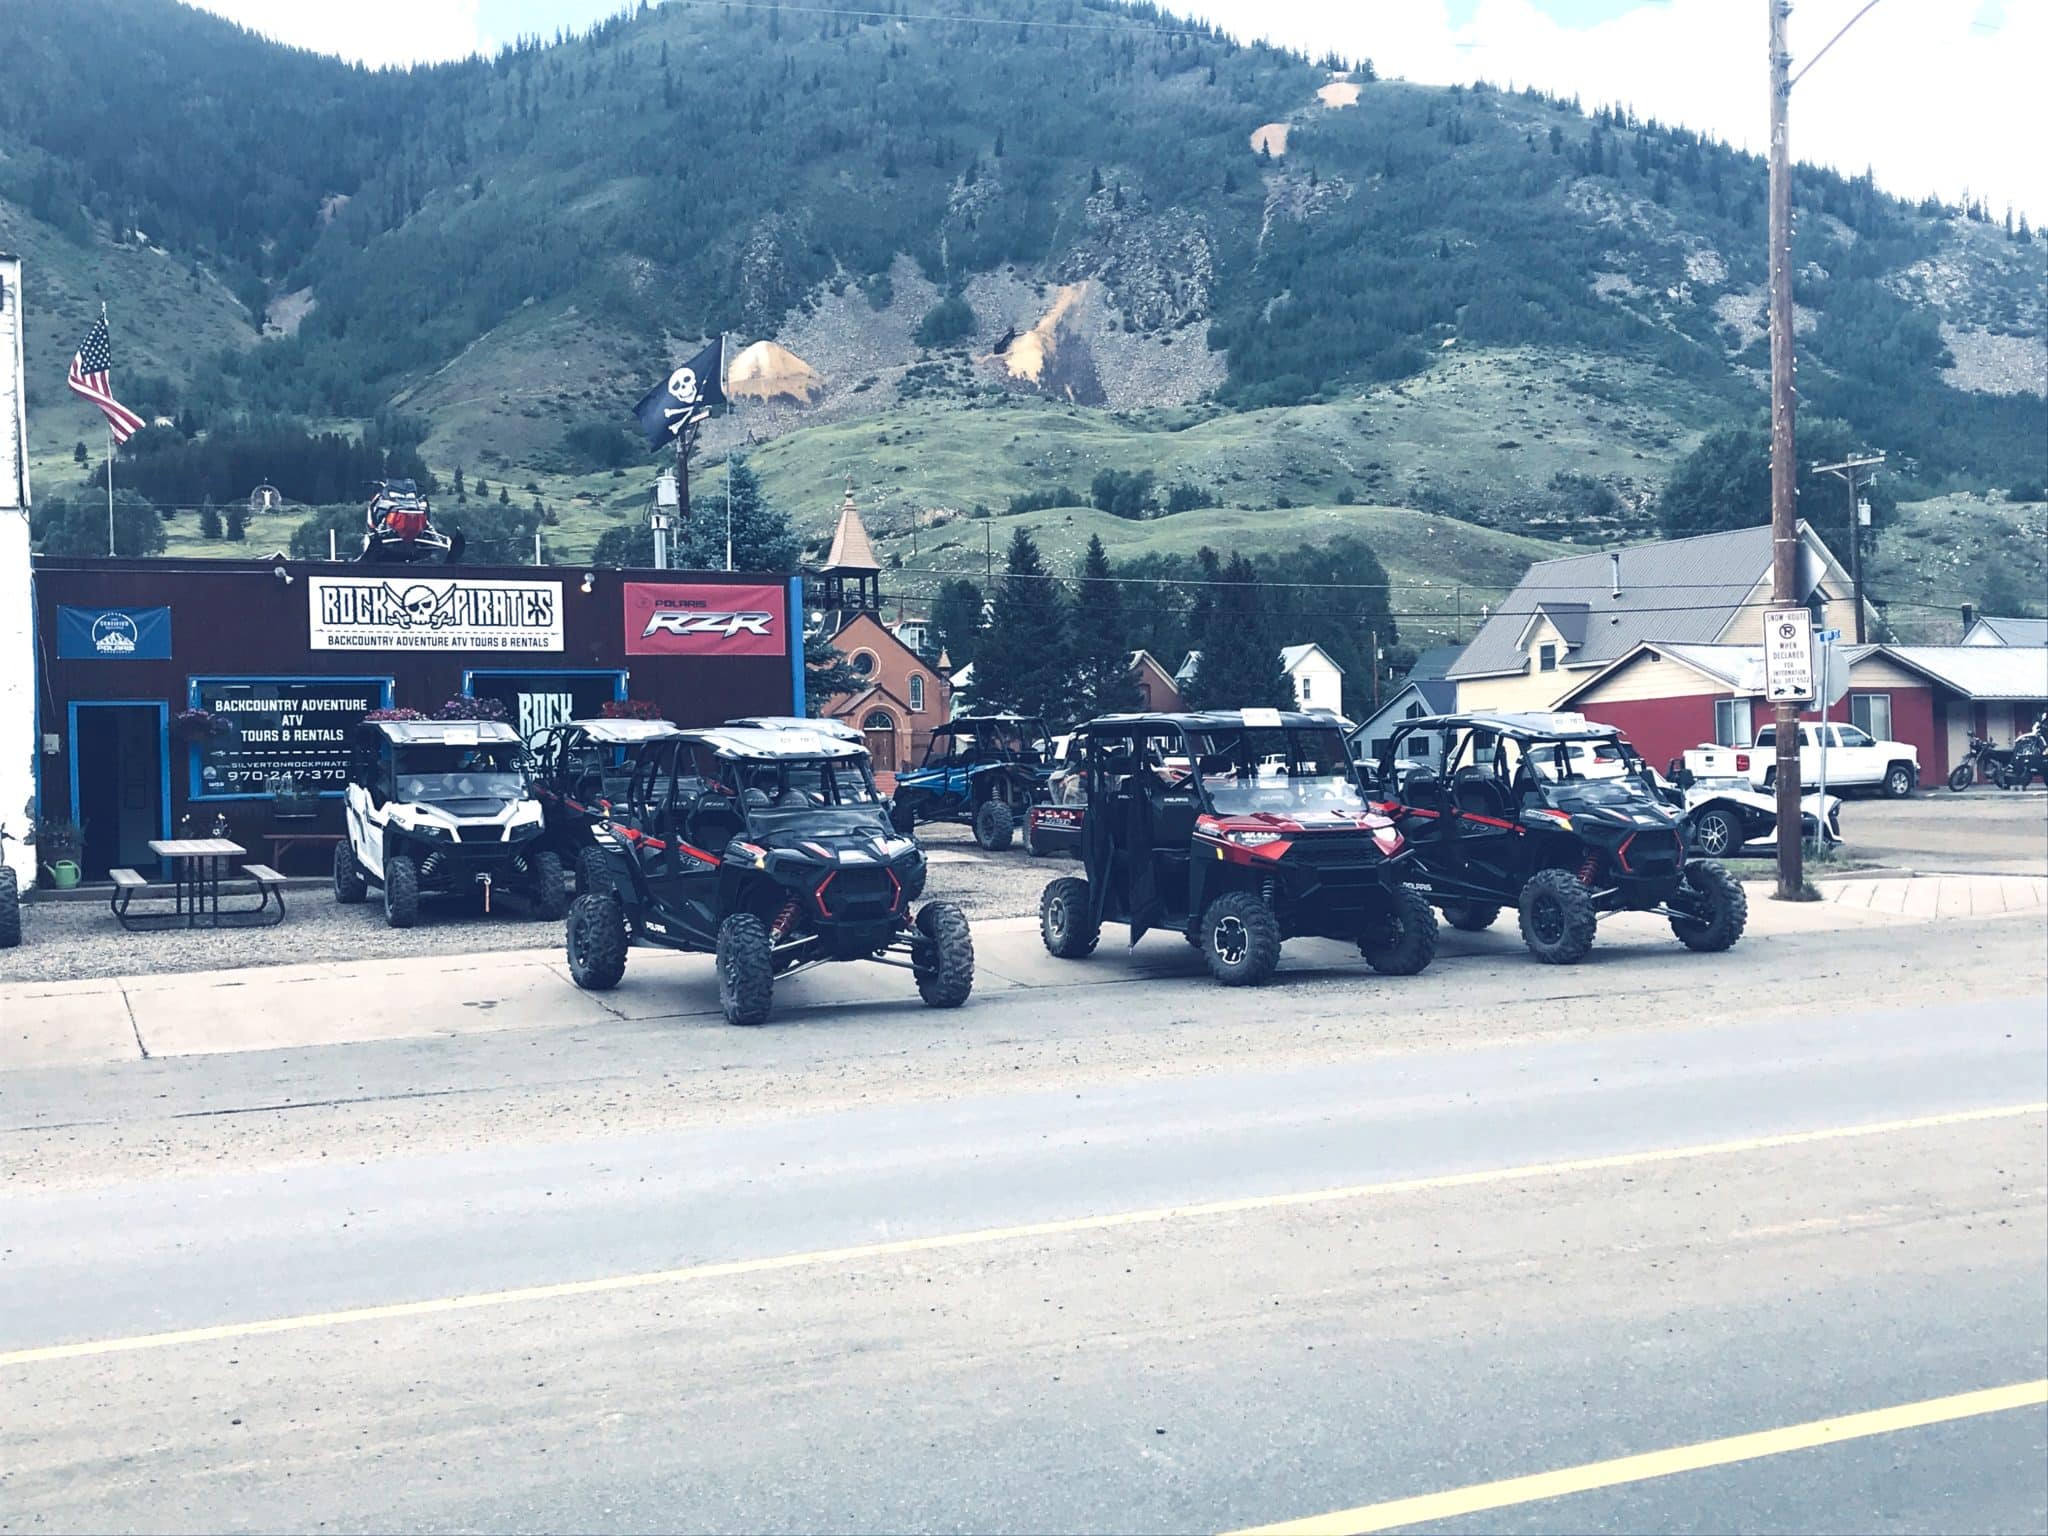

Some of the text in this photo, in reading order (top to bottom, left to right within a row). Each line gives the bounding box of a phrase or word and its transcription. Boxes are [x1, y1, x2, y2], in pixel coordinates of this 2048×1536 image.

[320, 585, 553, 627] ROCK PIRATES
[655, 600, 707, 608] POLARIS
[641, 610, 773, 639] RZR
[328, 635, 394, 646] BACKCOUNTRY
[396, 636, 449, 647] ADVENTURE
[451, 637, 468, 647] ATV
[470, 637, 499, 647] TOURS
[510, 637, 549, 647] RENTALS
[215, 699, 368, 712] BACKCOUNTRY ADVENTURE
[281, 714, 303, 727] ATV
[517, 693, 573, 740] ROCK
[241, 729, 344, 742] TOURS & RENTALS
[228, 770, 346, 781] 970-247-370
